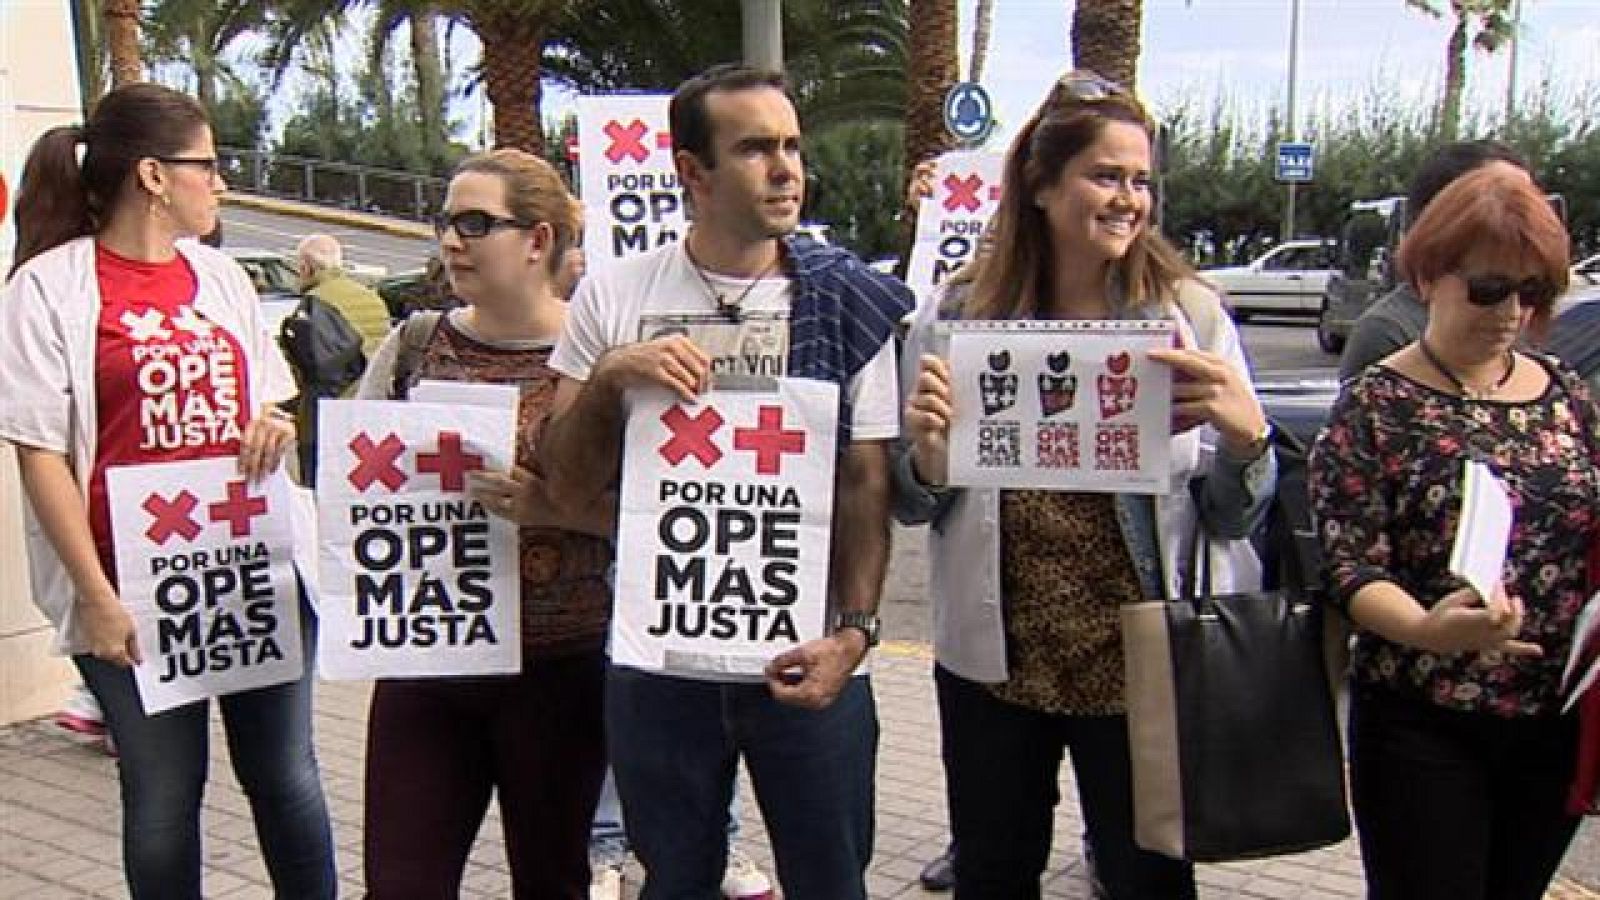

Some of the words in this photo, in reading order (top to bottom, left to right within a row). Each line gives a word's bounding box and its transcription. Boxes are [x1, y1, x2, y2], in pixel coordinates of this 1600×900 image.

[608, 174, 655, 191] POR
[610, 192, 679, 223] OP
[138, 352, 237, 394] OPE
[139, 419, 241, 449] JUSTA
[351, 503, 415, 526] POR
[423, 500, 489, 522] UNA
[659, 480, 726, 505] POR
[734, 484, 802, 508] UNA
[354, 523, 492, 572] OPE
[657, 506, 802, 559] OPE
[151, 552, 207, 576] POR
[214, 541, 271, 567] UNA
[155, 562, 275, 615] OPE
[355, 569, 495, 616] MÁS
[654, 554, 800, 606] MÁS
[159, 600, 277, 658] MÁS
[351, 614, 498, 649] JUSTA
[647, 603, 800, 642] JUSTA
[159, 638, 284, 683] JUSTA
